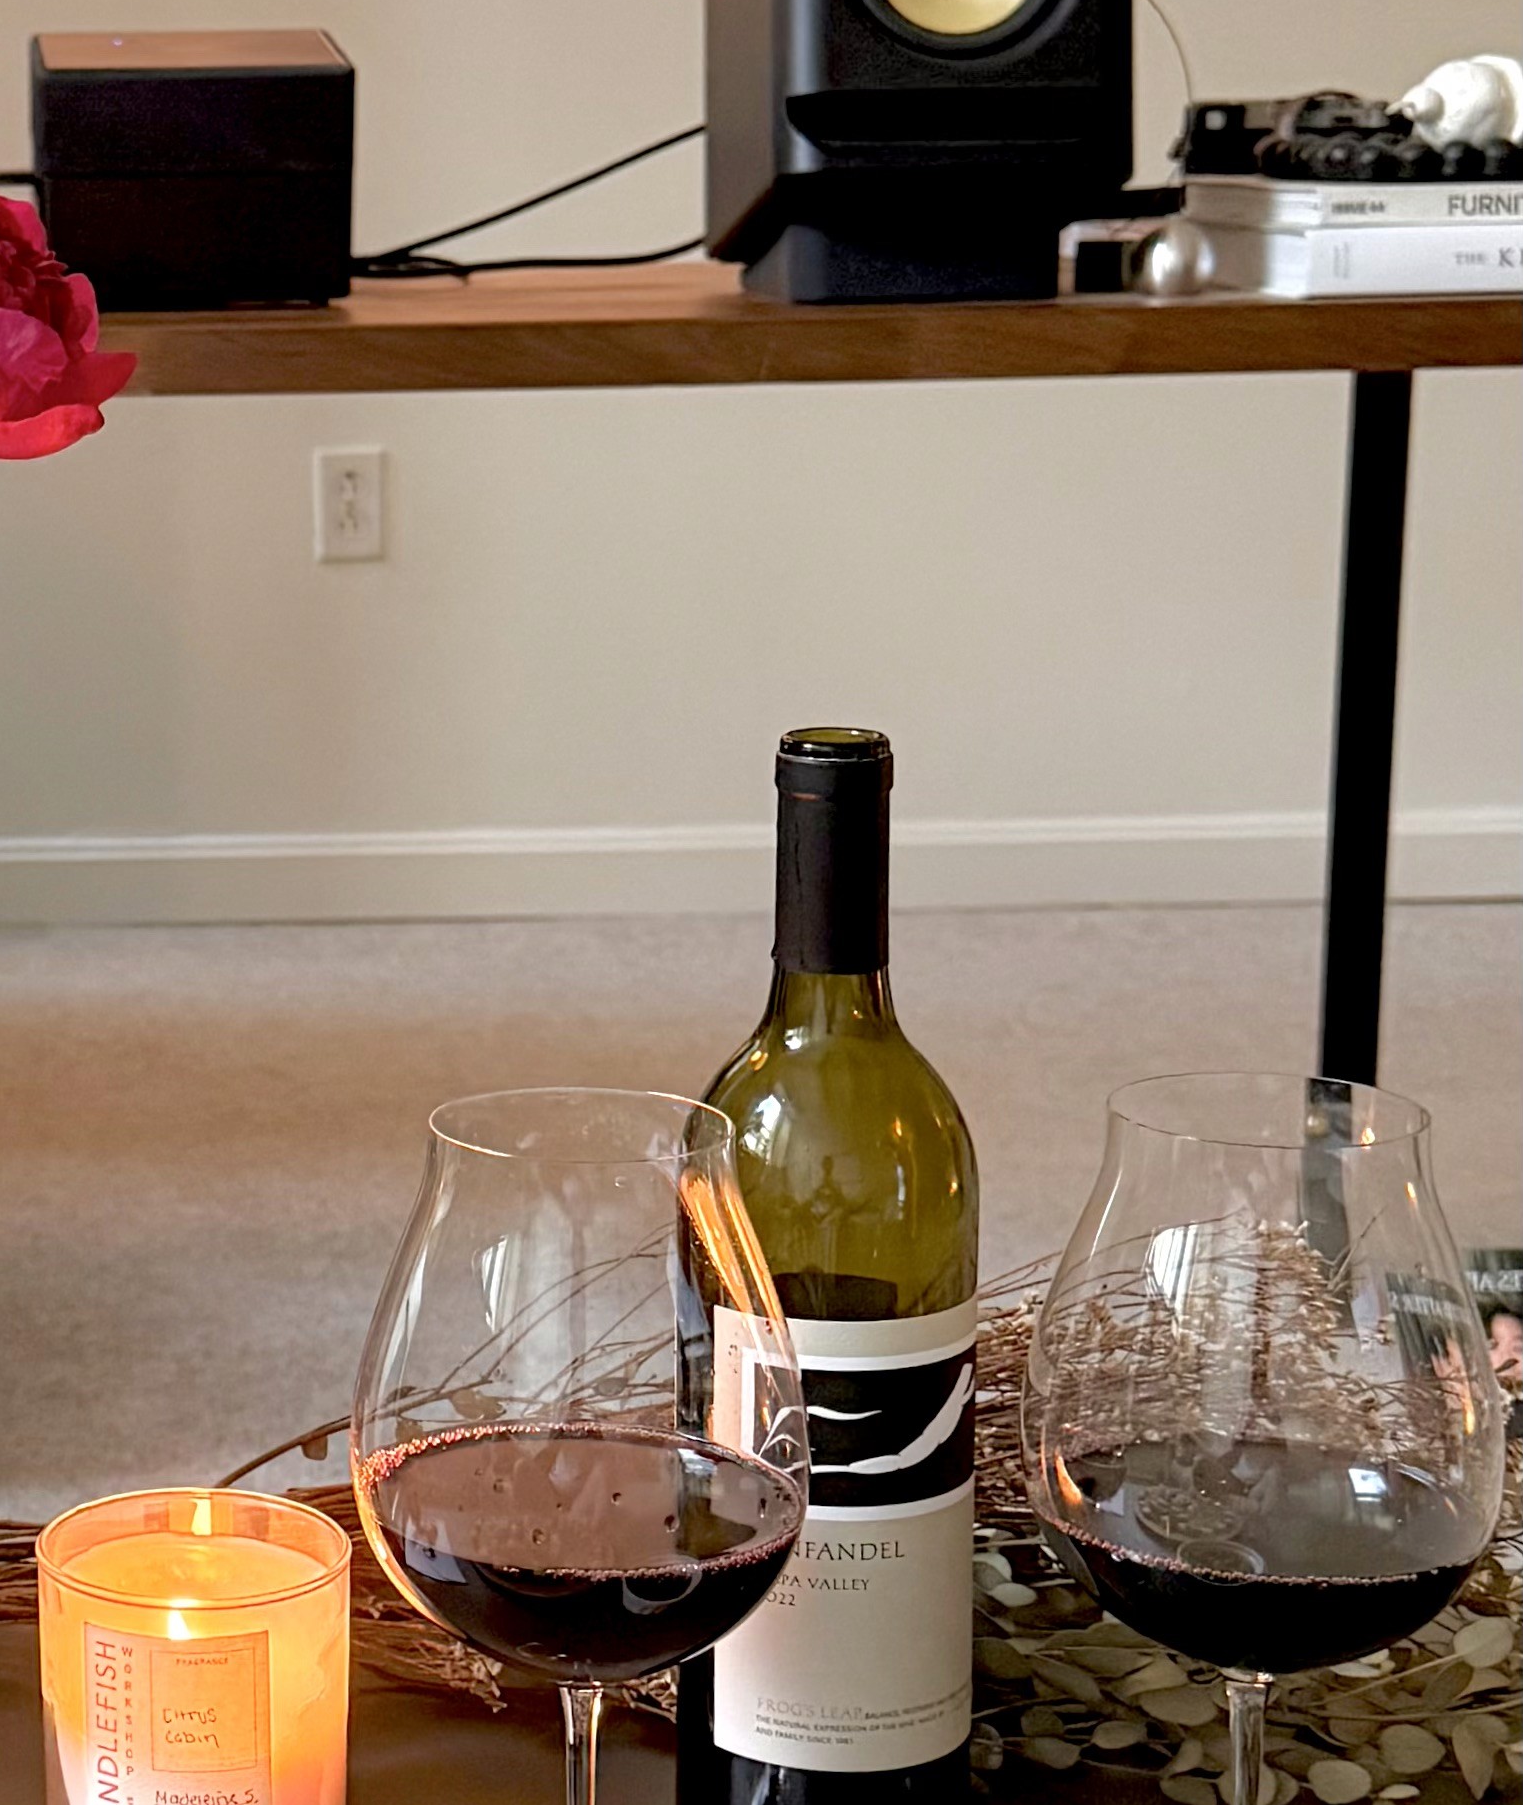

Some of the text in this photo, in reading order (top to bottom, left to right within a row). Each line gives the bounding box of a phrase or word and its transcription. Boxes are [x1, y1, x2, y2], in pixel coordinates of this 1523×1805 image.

[1447, 193, 1523, 217] FURNI
[792, 1540, 906, 1562] NFANDEL
[778, 1573, 871, 1591] PA VALLEY
[766, 1592, 797, 1607] 022
[175, 1657, 229, 1667] FRAGRANCE
[122, 1645, 135, 1776] WORKSHOP
[820, 1706, 862, 1721] LEAP
